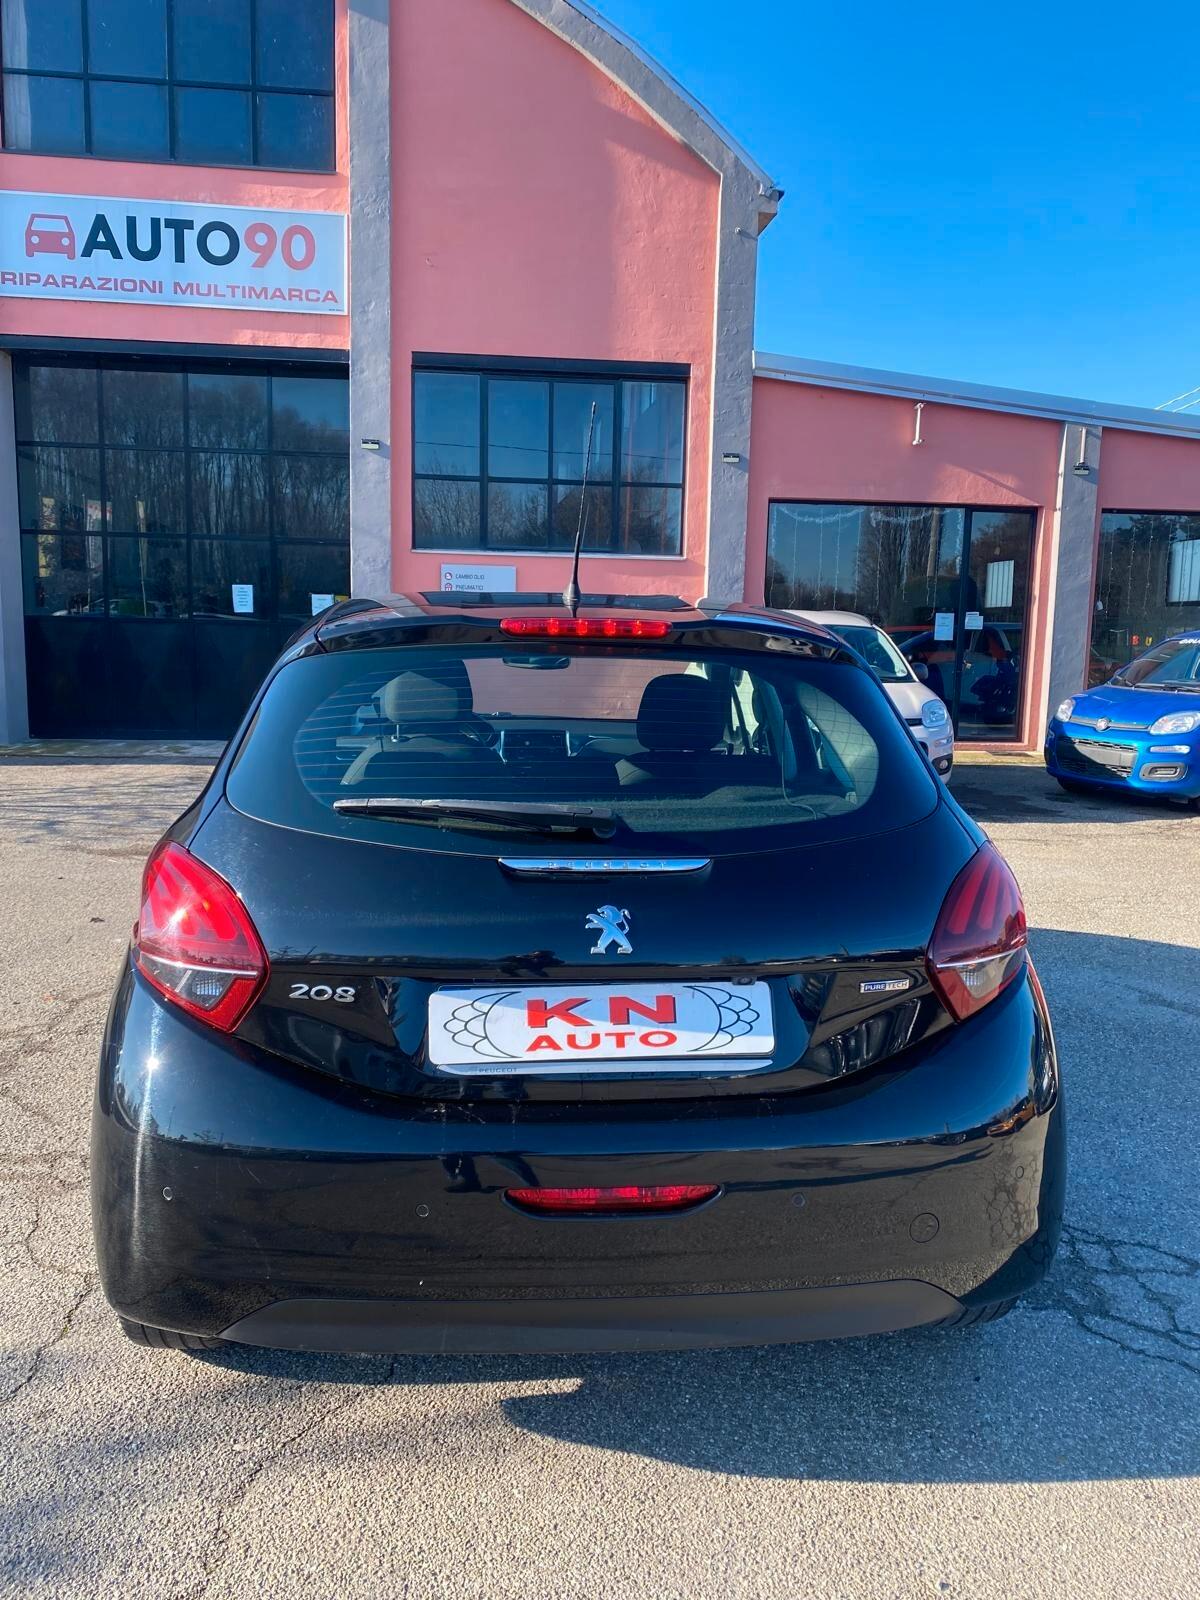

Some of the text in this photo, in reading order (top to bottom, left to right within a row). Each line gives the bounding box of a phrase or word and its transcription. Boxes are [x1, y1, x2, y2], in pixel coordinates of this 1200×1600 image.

[0, 271, 338, 303] RIPARAZIONI MULTIMARCA
[288, 983, 356, 1003] 208
[525, 1030, 678, 1052] AUTO
